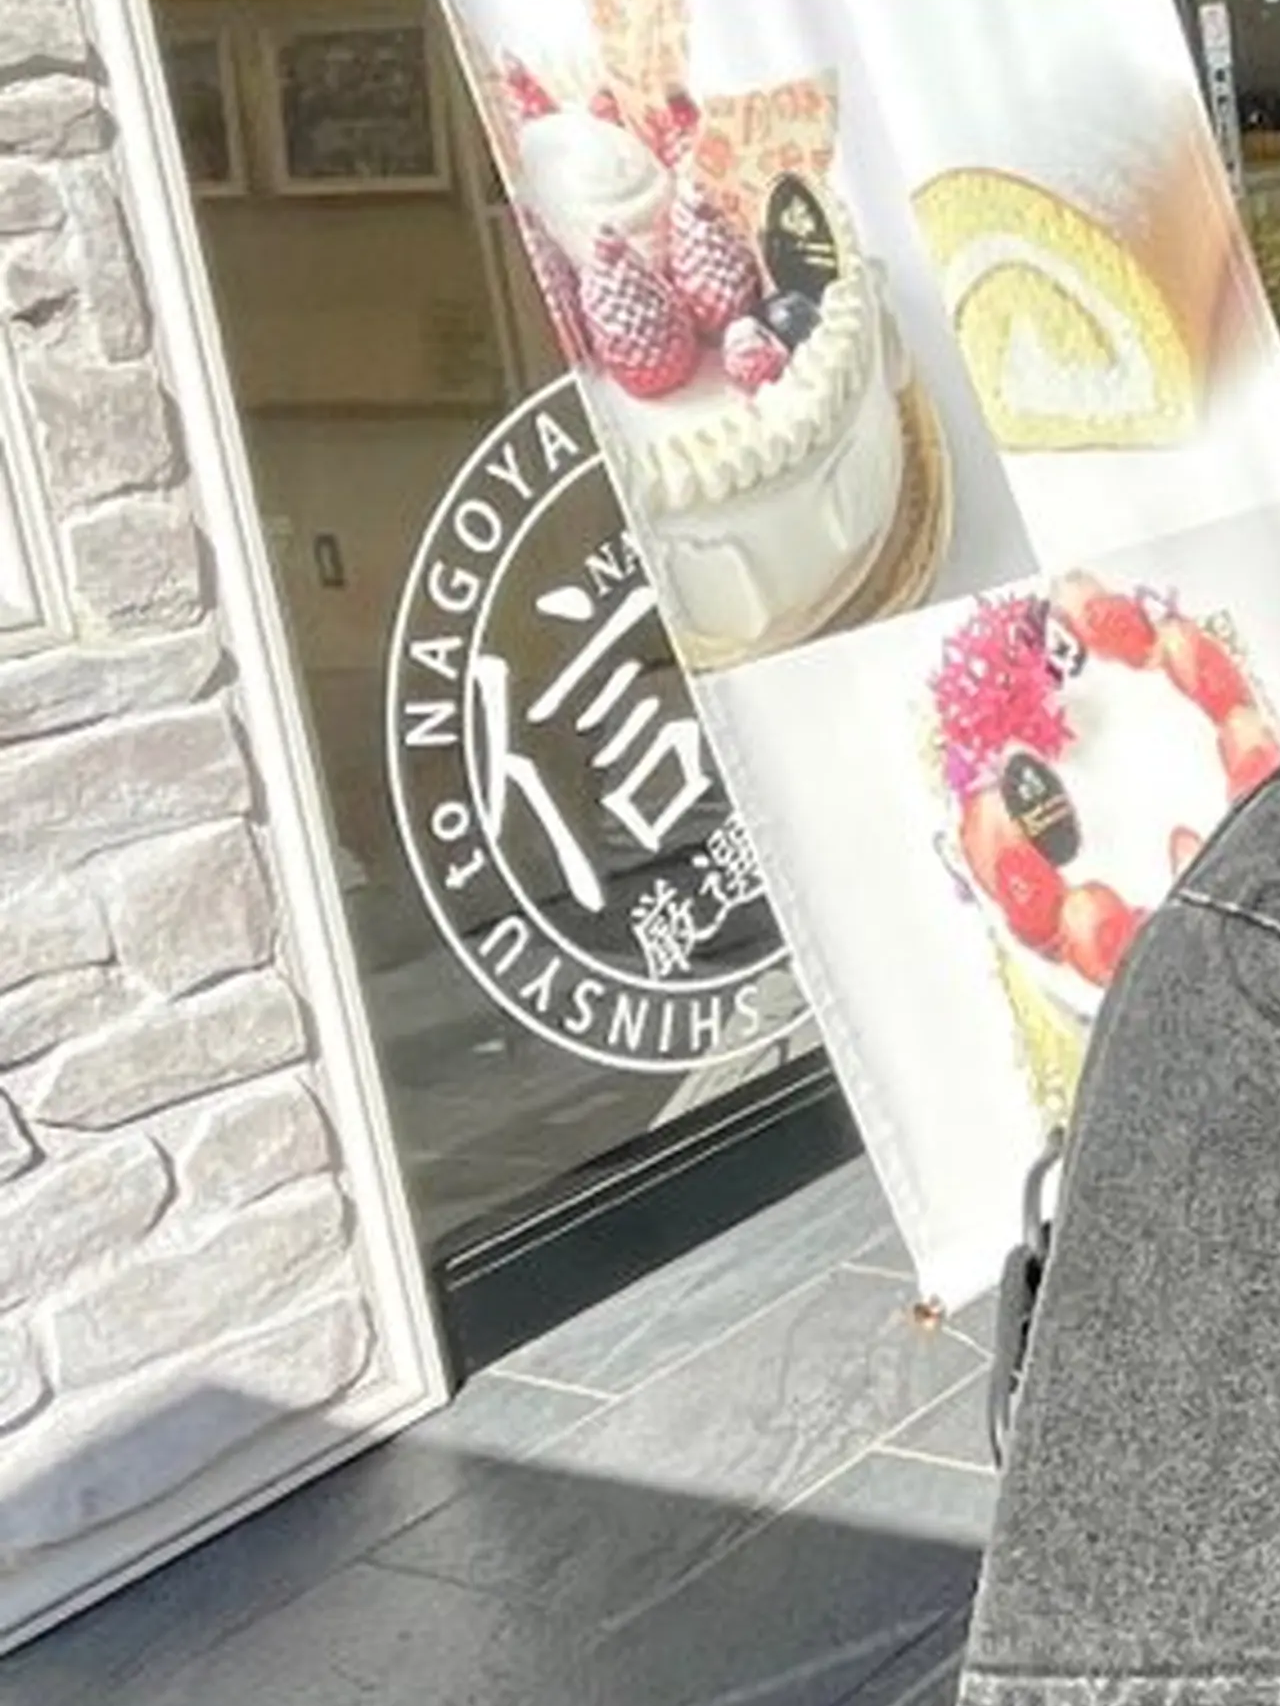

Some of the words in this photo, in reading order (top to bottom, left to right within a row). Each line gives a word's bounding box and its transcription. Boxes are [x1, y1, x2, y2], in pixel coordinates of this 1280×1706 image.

[403, 408, 582, 749] NAGOYA
[431, 800, 486, 891] to
[478, 915, 761, 1054] SHINSYU
